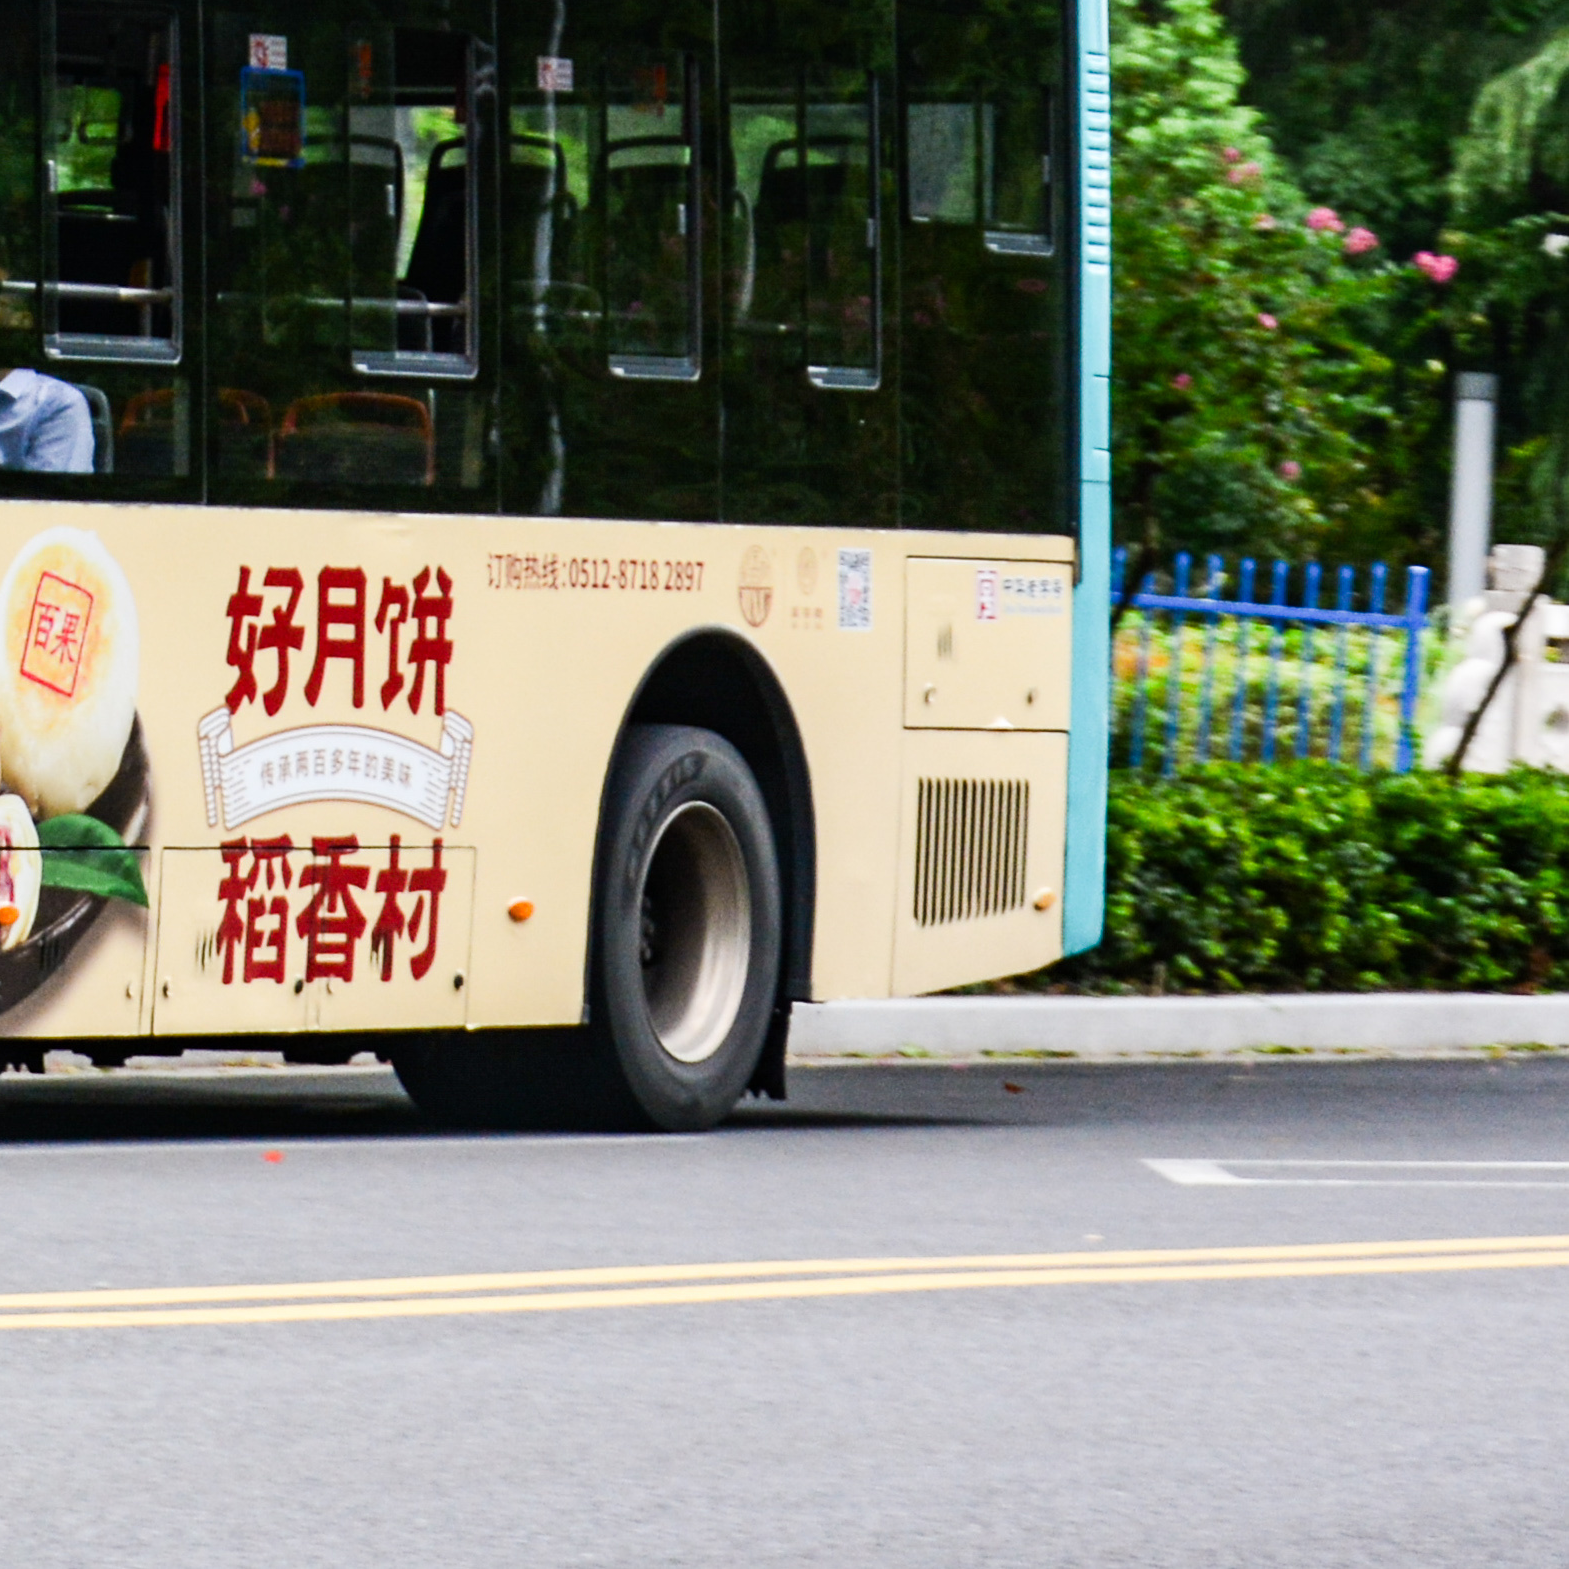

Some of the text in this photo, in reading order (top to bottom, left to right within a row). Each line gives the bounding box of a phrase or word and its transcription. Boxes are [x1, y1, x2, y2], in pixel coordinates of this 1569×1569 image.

[33, 600, 80, 664] 百果
[225, 564, 453, 717] 好月饼
[216, 833, 448, 984] 稻香村
